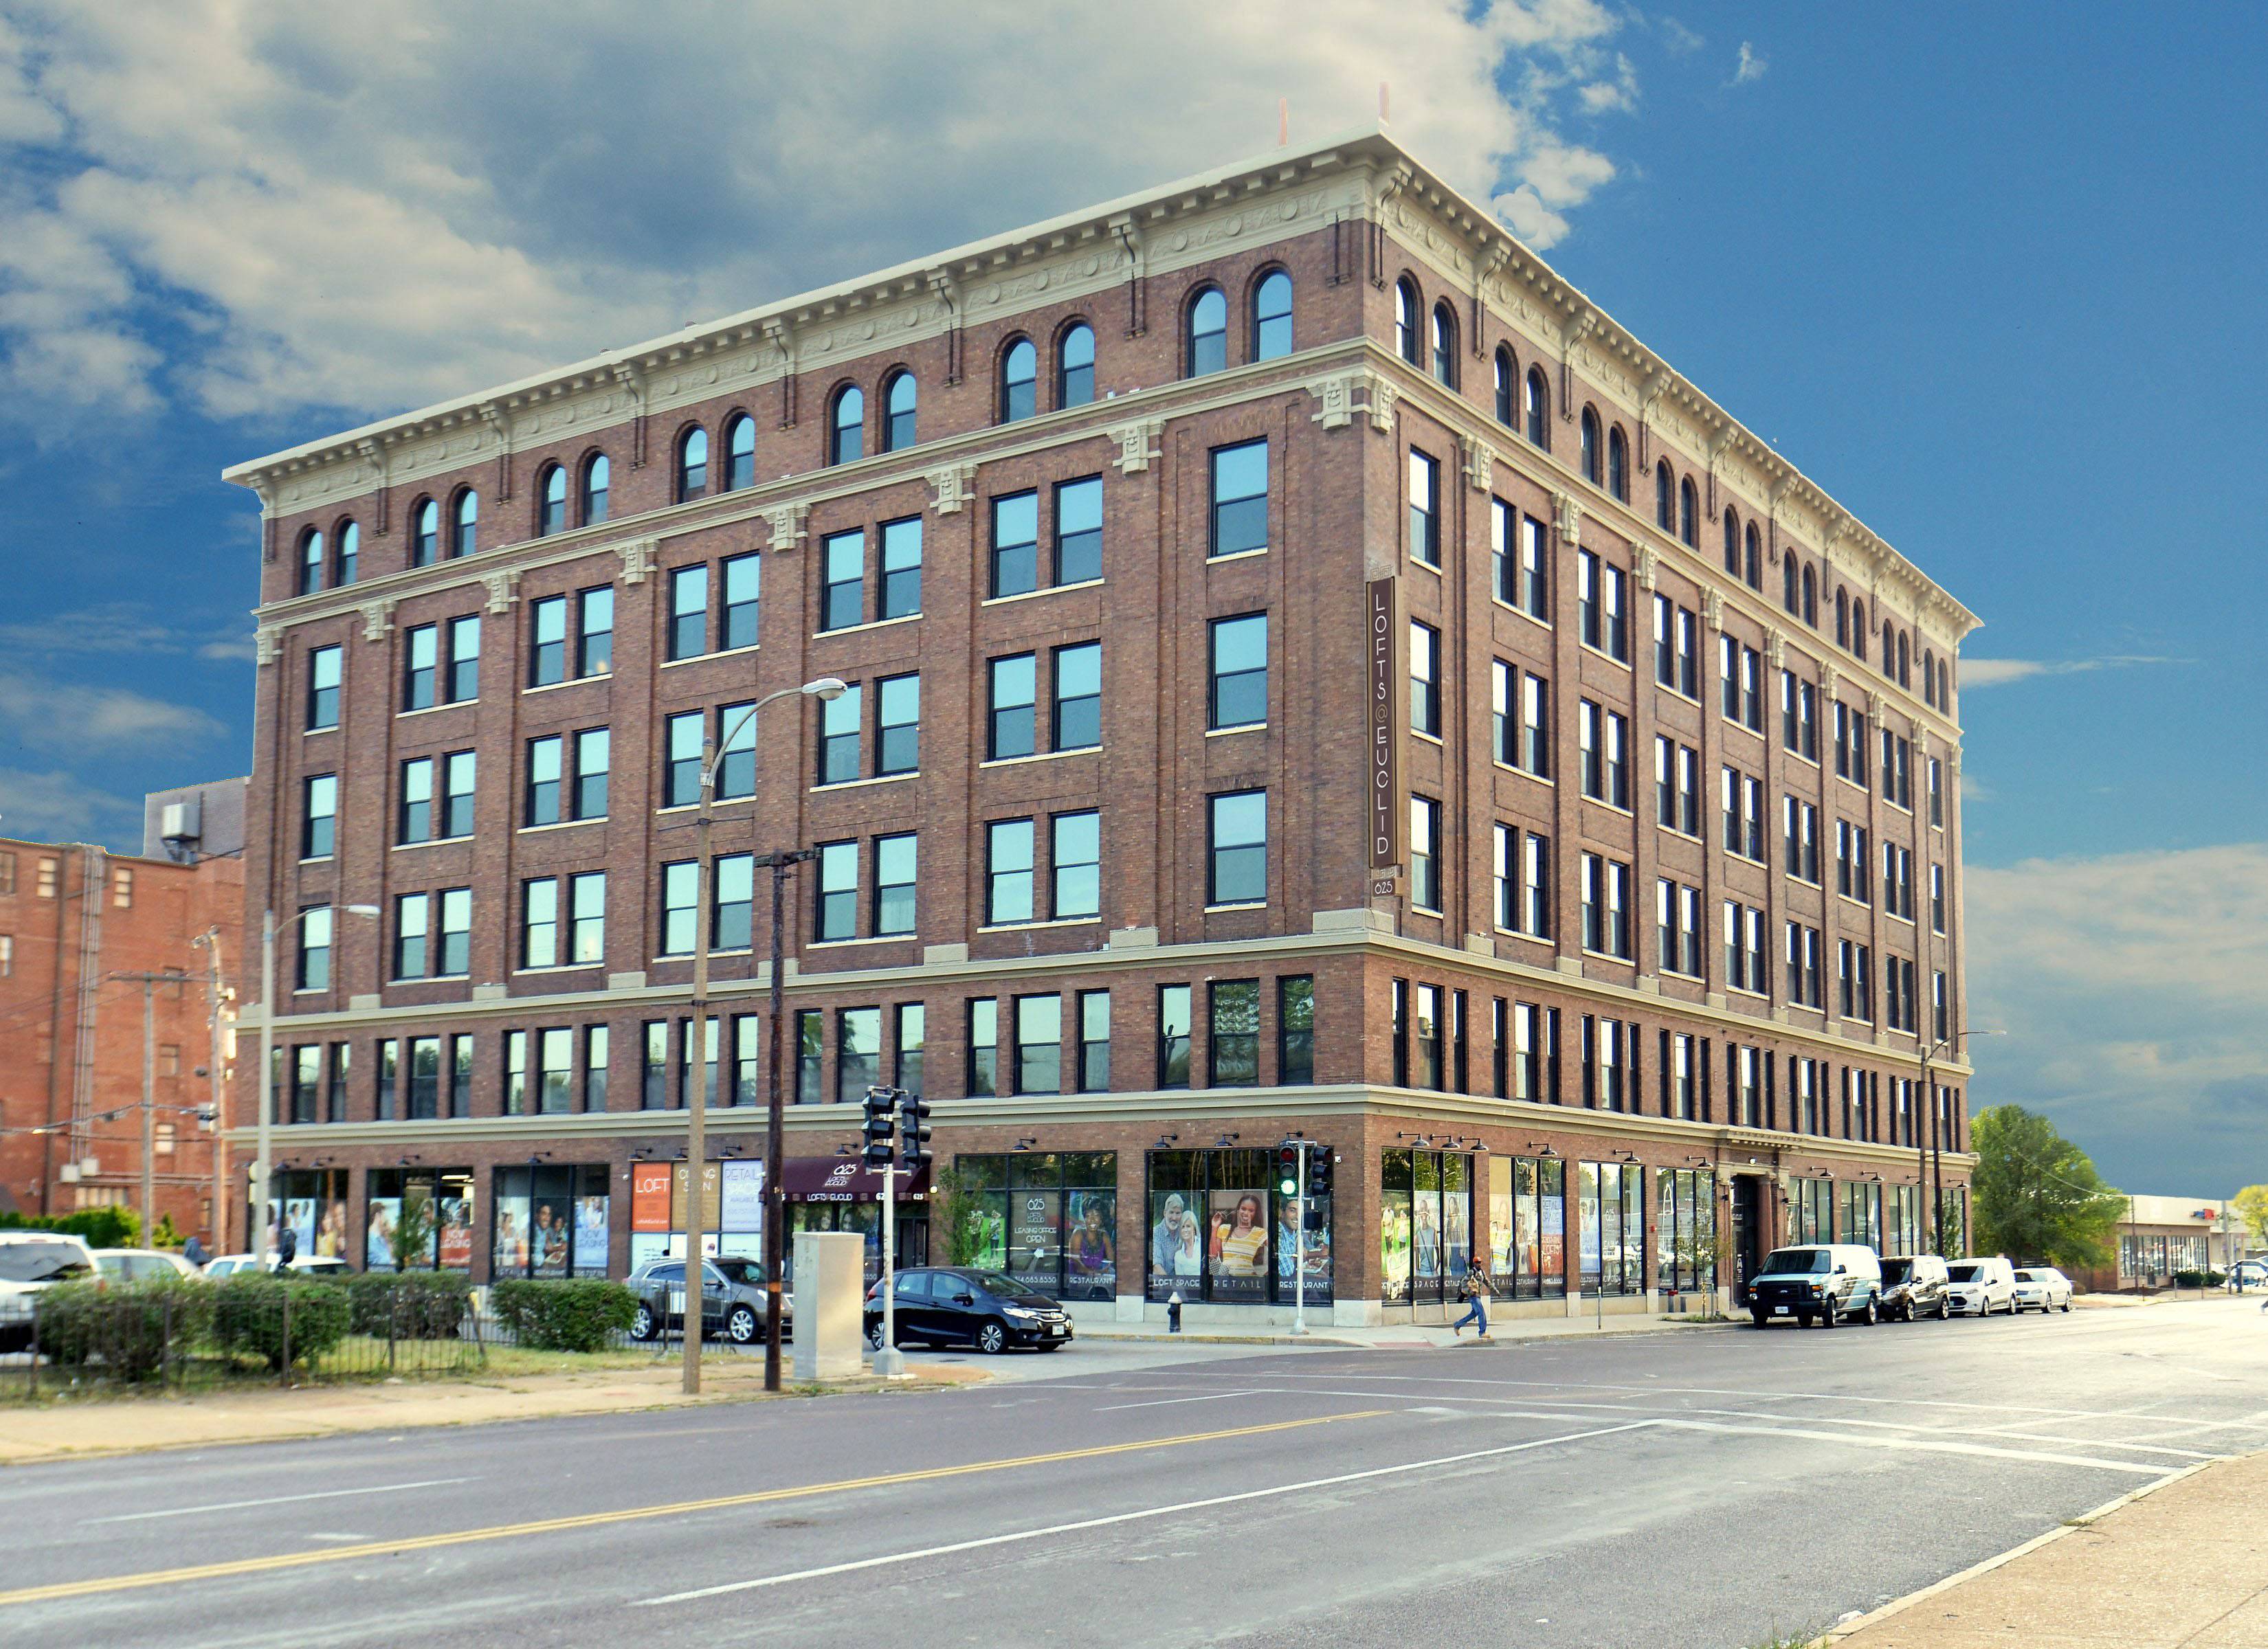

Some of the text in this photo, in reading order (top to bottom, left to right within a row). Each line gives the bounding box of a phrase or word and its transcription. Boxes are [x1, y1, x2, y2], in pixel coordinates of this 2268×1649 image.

[1375, 880, 1393, 895] 625
[834, 1164, 856, 1176] 625
[636, 1178, 669, 1193] LOFT
[1027, 1198, 1045, 1210] 625
[1069, 1277, 1113, 1285] RESTAURANT
[1214, 1280, 1261, 1288] RETAIL
